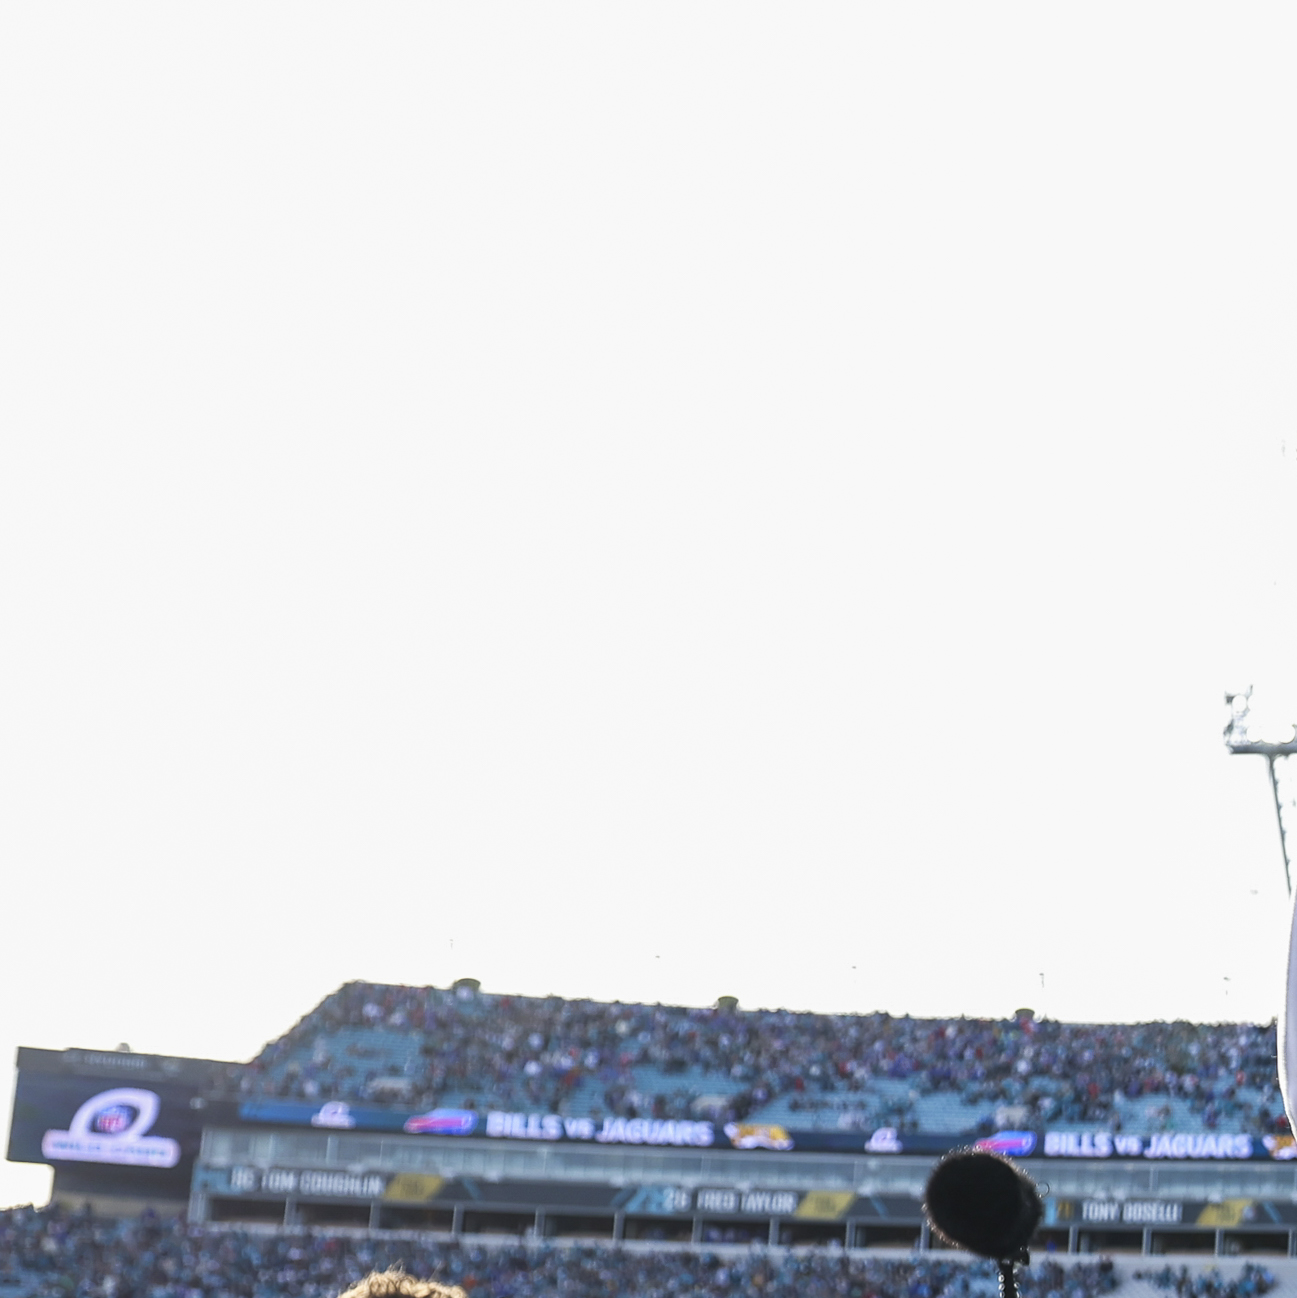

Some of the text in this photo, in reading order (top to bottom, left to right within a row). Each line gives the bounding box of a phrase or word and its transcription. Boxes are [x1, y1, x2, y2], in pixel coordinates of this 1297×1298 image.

[486, 1110, 563, 1140] BILLS
[595, 1115, 716, 1147] JAGUARS
[1044, 1132, 1112, 1158] BILLS
[1143, 1133, 1253, 1159] JAGUARS
[1081, 1201, 1119, 1222] TONY
